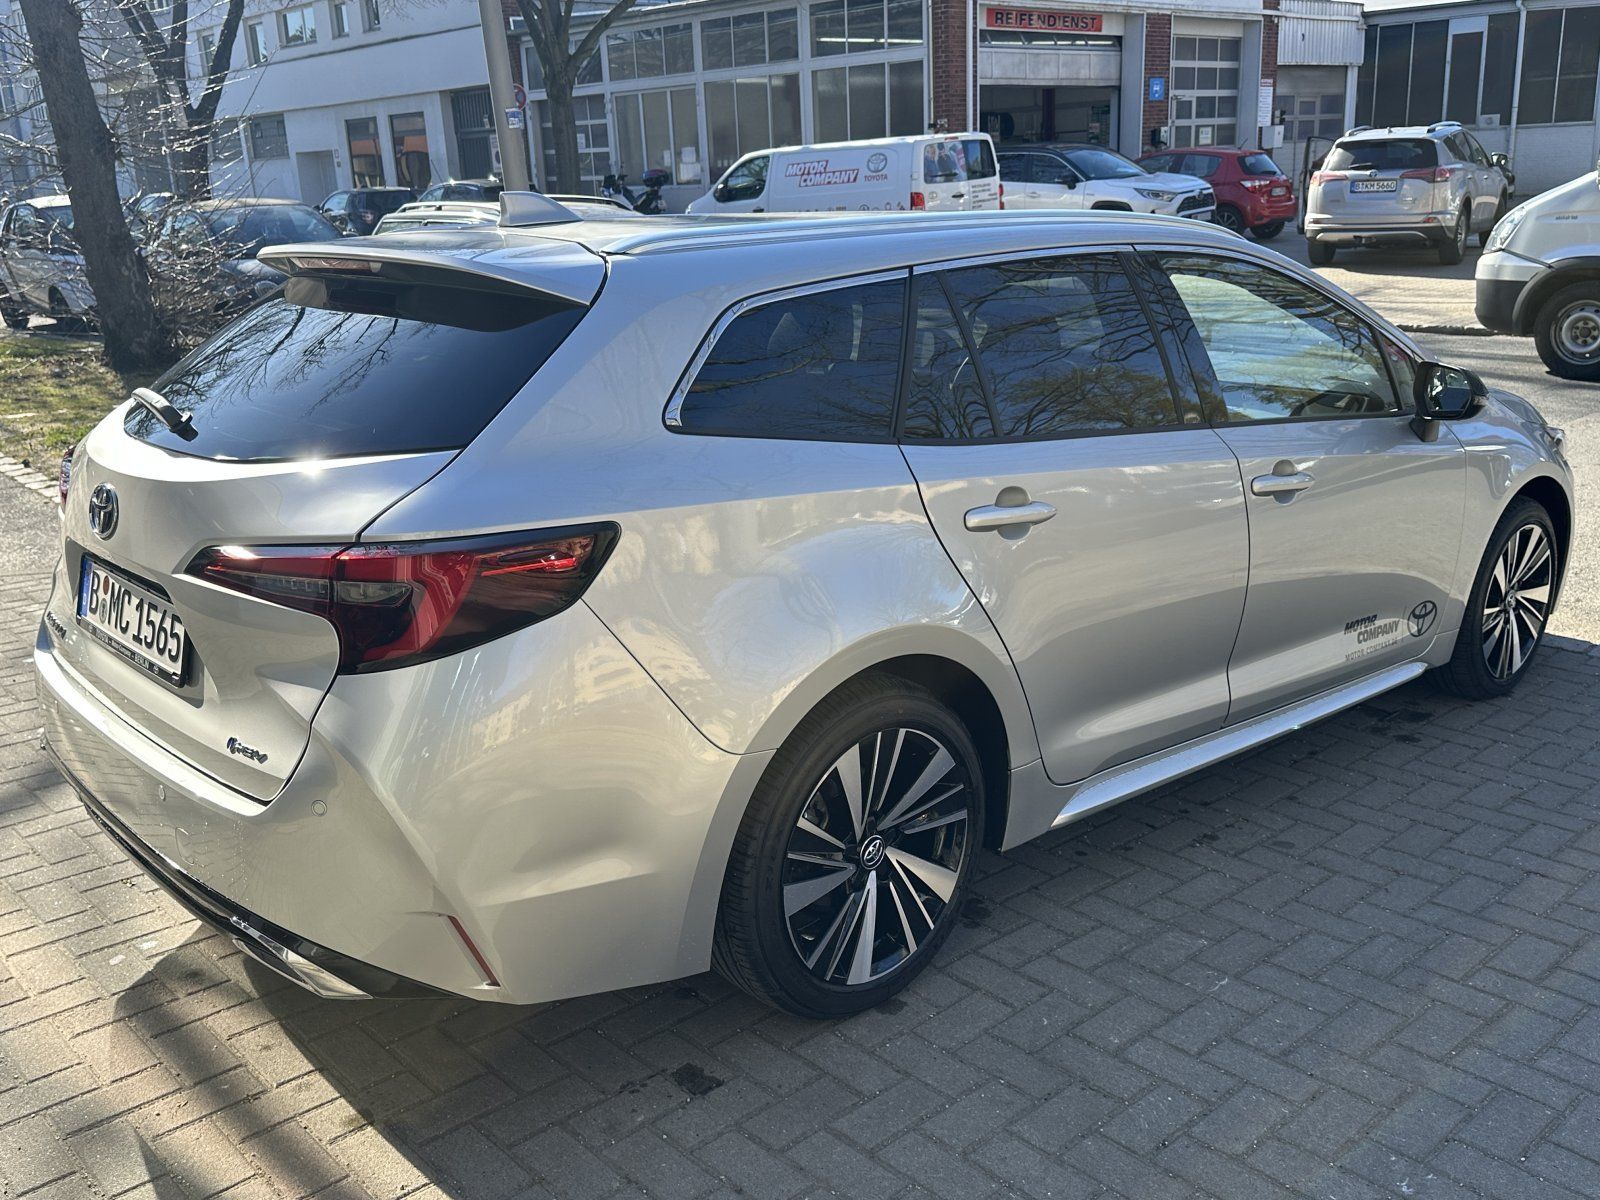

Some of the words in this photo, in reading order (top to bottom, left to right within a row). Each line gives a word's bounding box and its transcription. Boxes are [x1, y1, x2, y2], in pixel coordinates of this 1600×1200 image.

[994, 11, 1097, 29] REIFENDIENST
[785, 160, 828, 177] MOTOR
[800, 170, 859, 187] COMPANY
[864, 174, 888, 182] TOYOTA
[89, 570, 101, 616] B
[108, 582, 132, 635] MC
[132, 598, 182, 663] 1565
[1344, 614, 1378, 635] MOTOR
[1357, 620, 1400, 644] COMPANY
